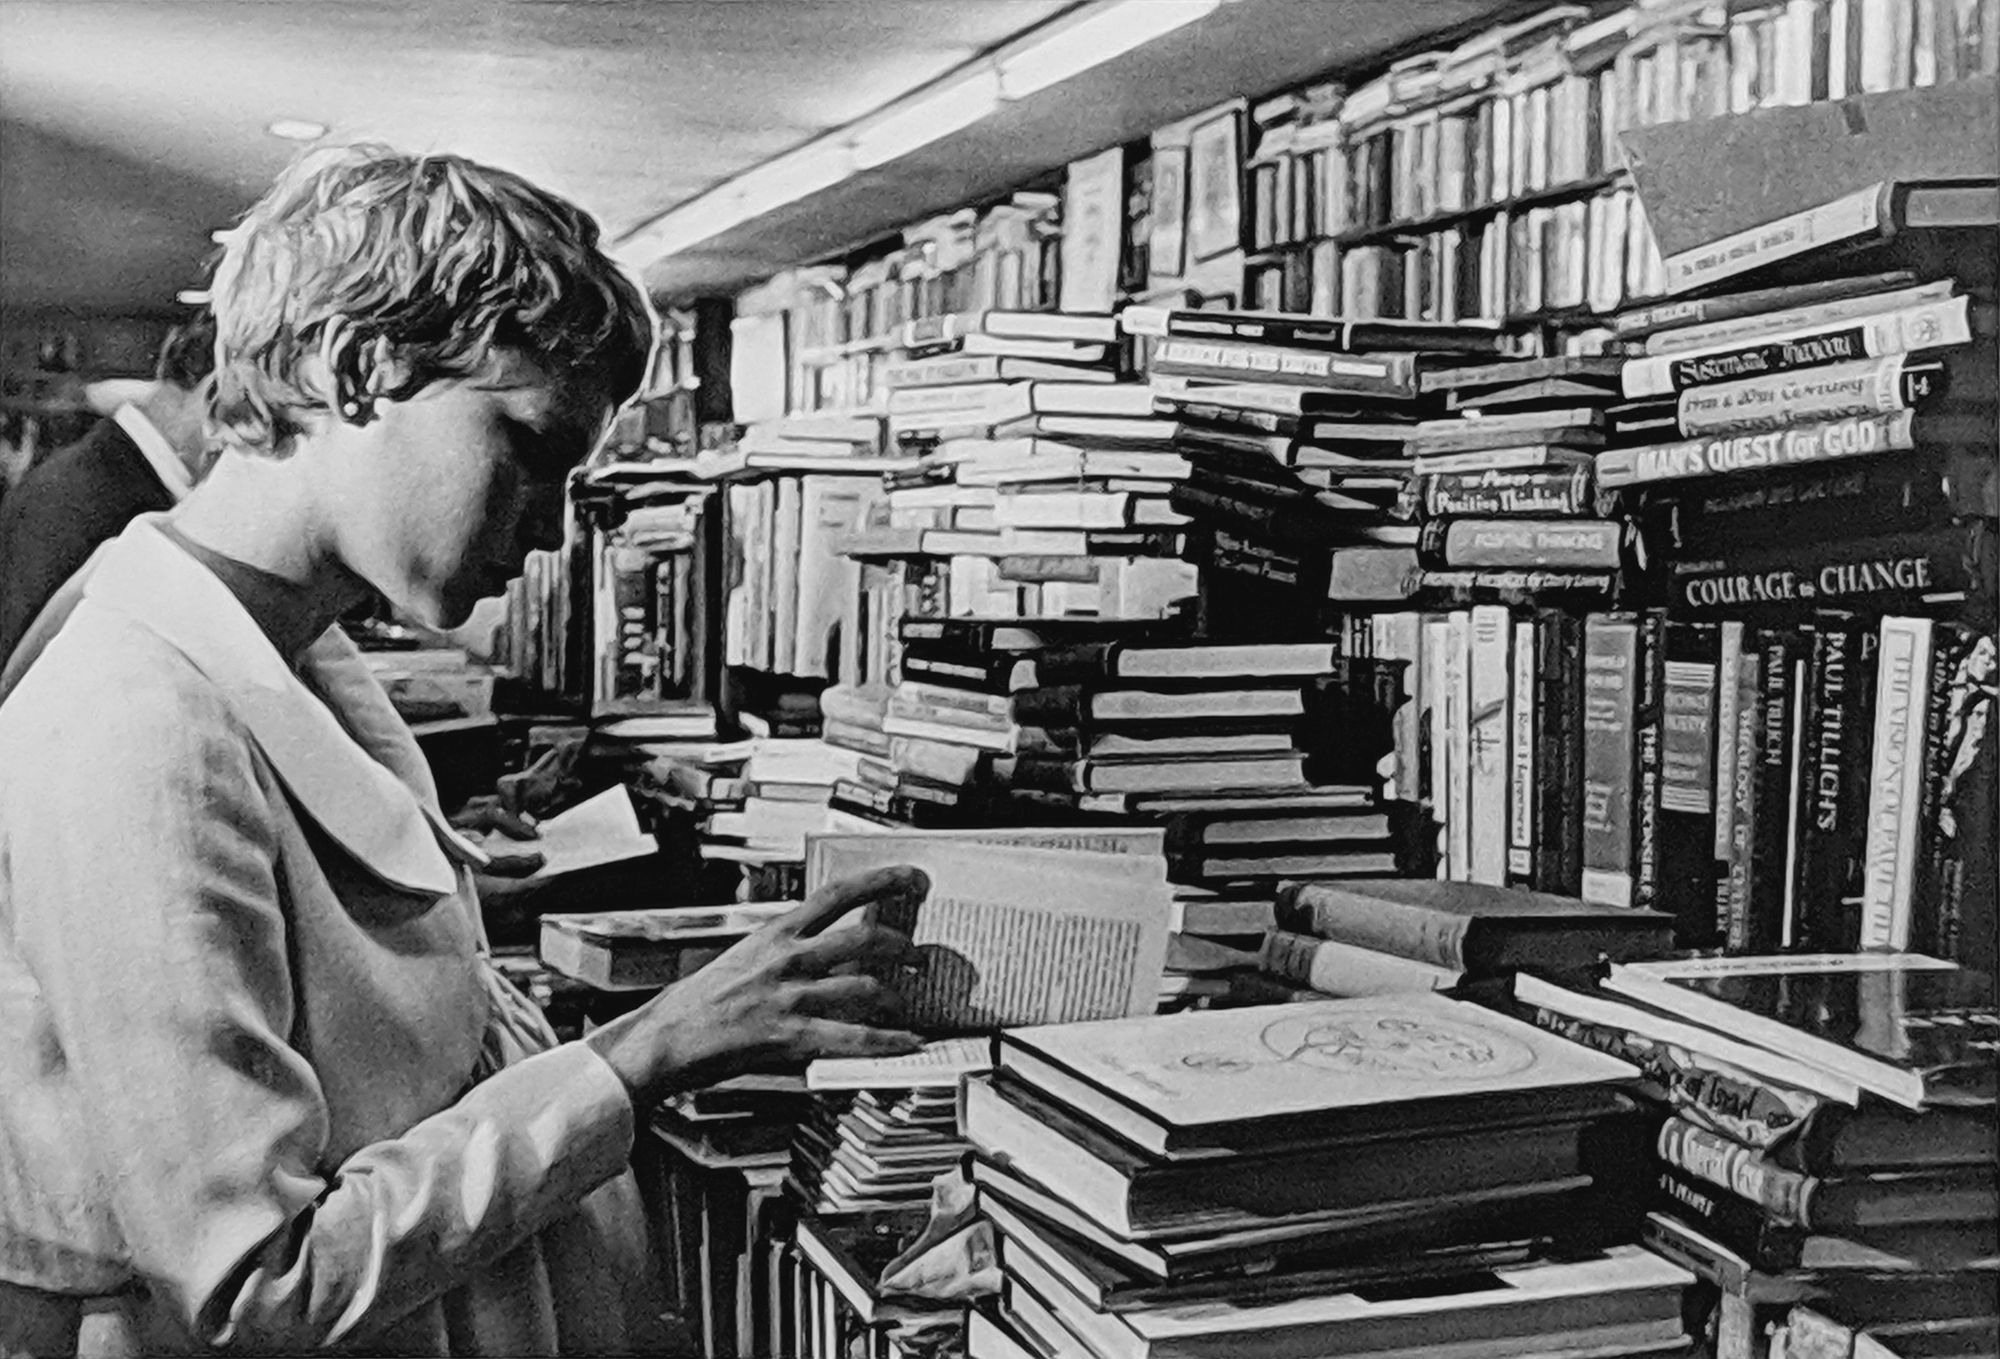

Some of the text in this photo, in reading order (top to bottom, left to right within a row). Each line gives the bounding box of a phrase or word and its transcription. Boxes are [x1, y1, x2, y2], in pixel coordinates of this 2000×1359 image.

[1636, 444, 1704, 482] MAN'S
[1708, 432, 1784, 472] QUEST
[1785, 429, 1819, 459] for
[1823, 418, 1876, 456] GOD
[1685, 571, 1797, 607] COURAGE
[1818, 557, 1932, 595] CHANGE
[1816, 631, 1848, 833] PAUL TILLICH'S
